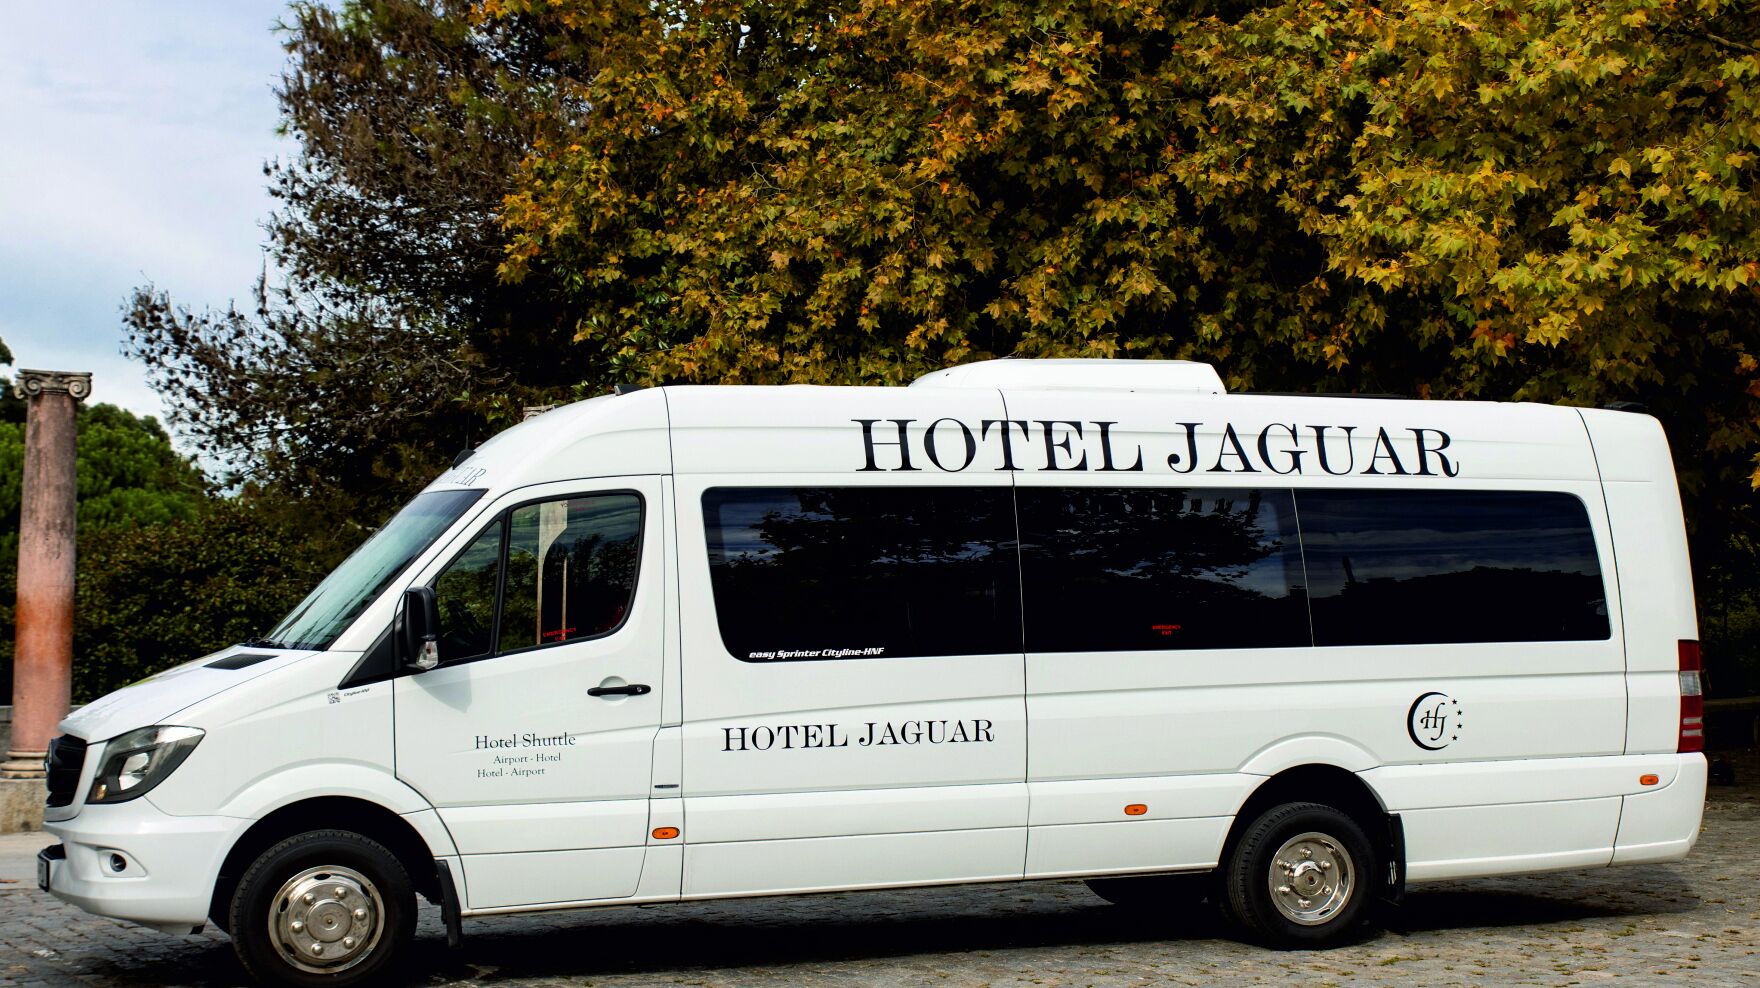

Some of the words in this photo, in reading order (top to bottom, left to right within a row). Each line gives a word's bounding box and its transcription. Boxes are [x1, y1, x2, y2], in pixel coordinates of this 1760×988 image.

[850, 417, 1144, 474] HOTEL
[1167, 422, 1460, 478] JAGUAR
[749, 651, 775, 660] easy
[777, 649, 821, 660] Sprinter
[821, 647, 885, 658] Cityline-HNF
[475, 733, 517, 750] Hotel
[522, 731, 576, 748] Shuttle
[721, 724, 848, 752] HOTEL
[858, 719, 995, 747] JAGUAR
[493, 755, 528, 766] Airport
[536, 752, 561, 762] Hotel
[477, 767, 503, 778] Hotel
[510, 767, 545, 778] Airport
